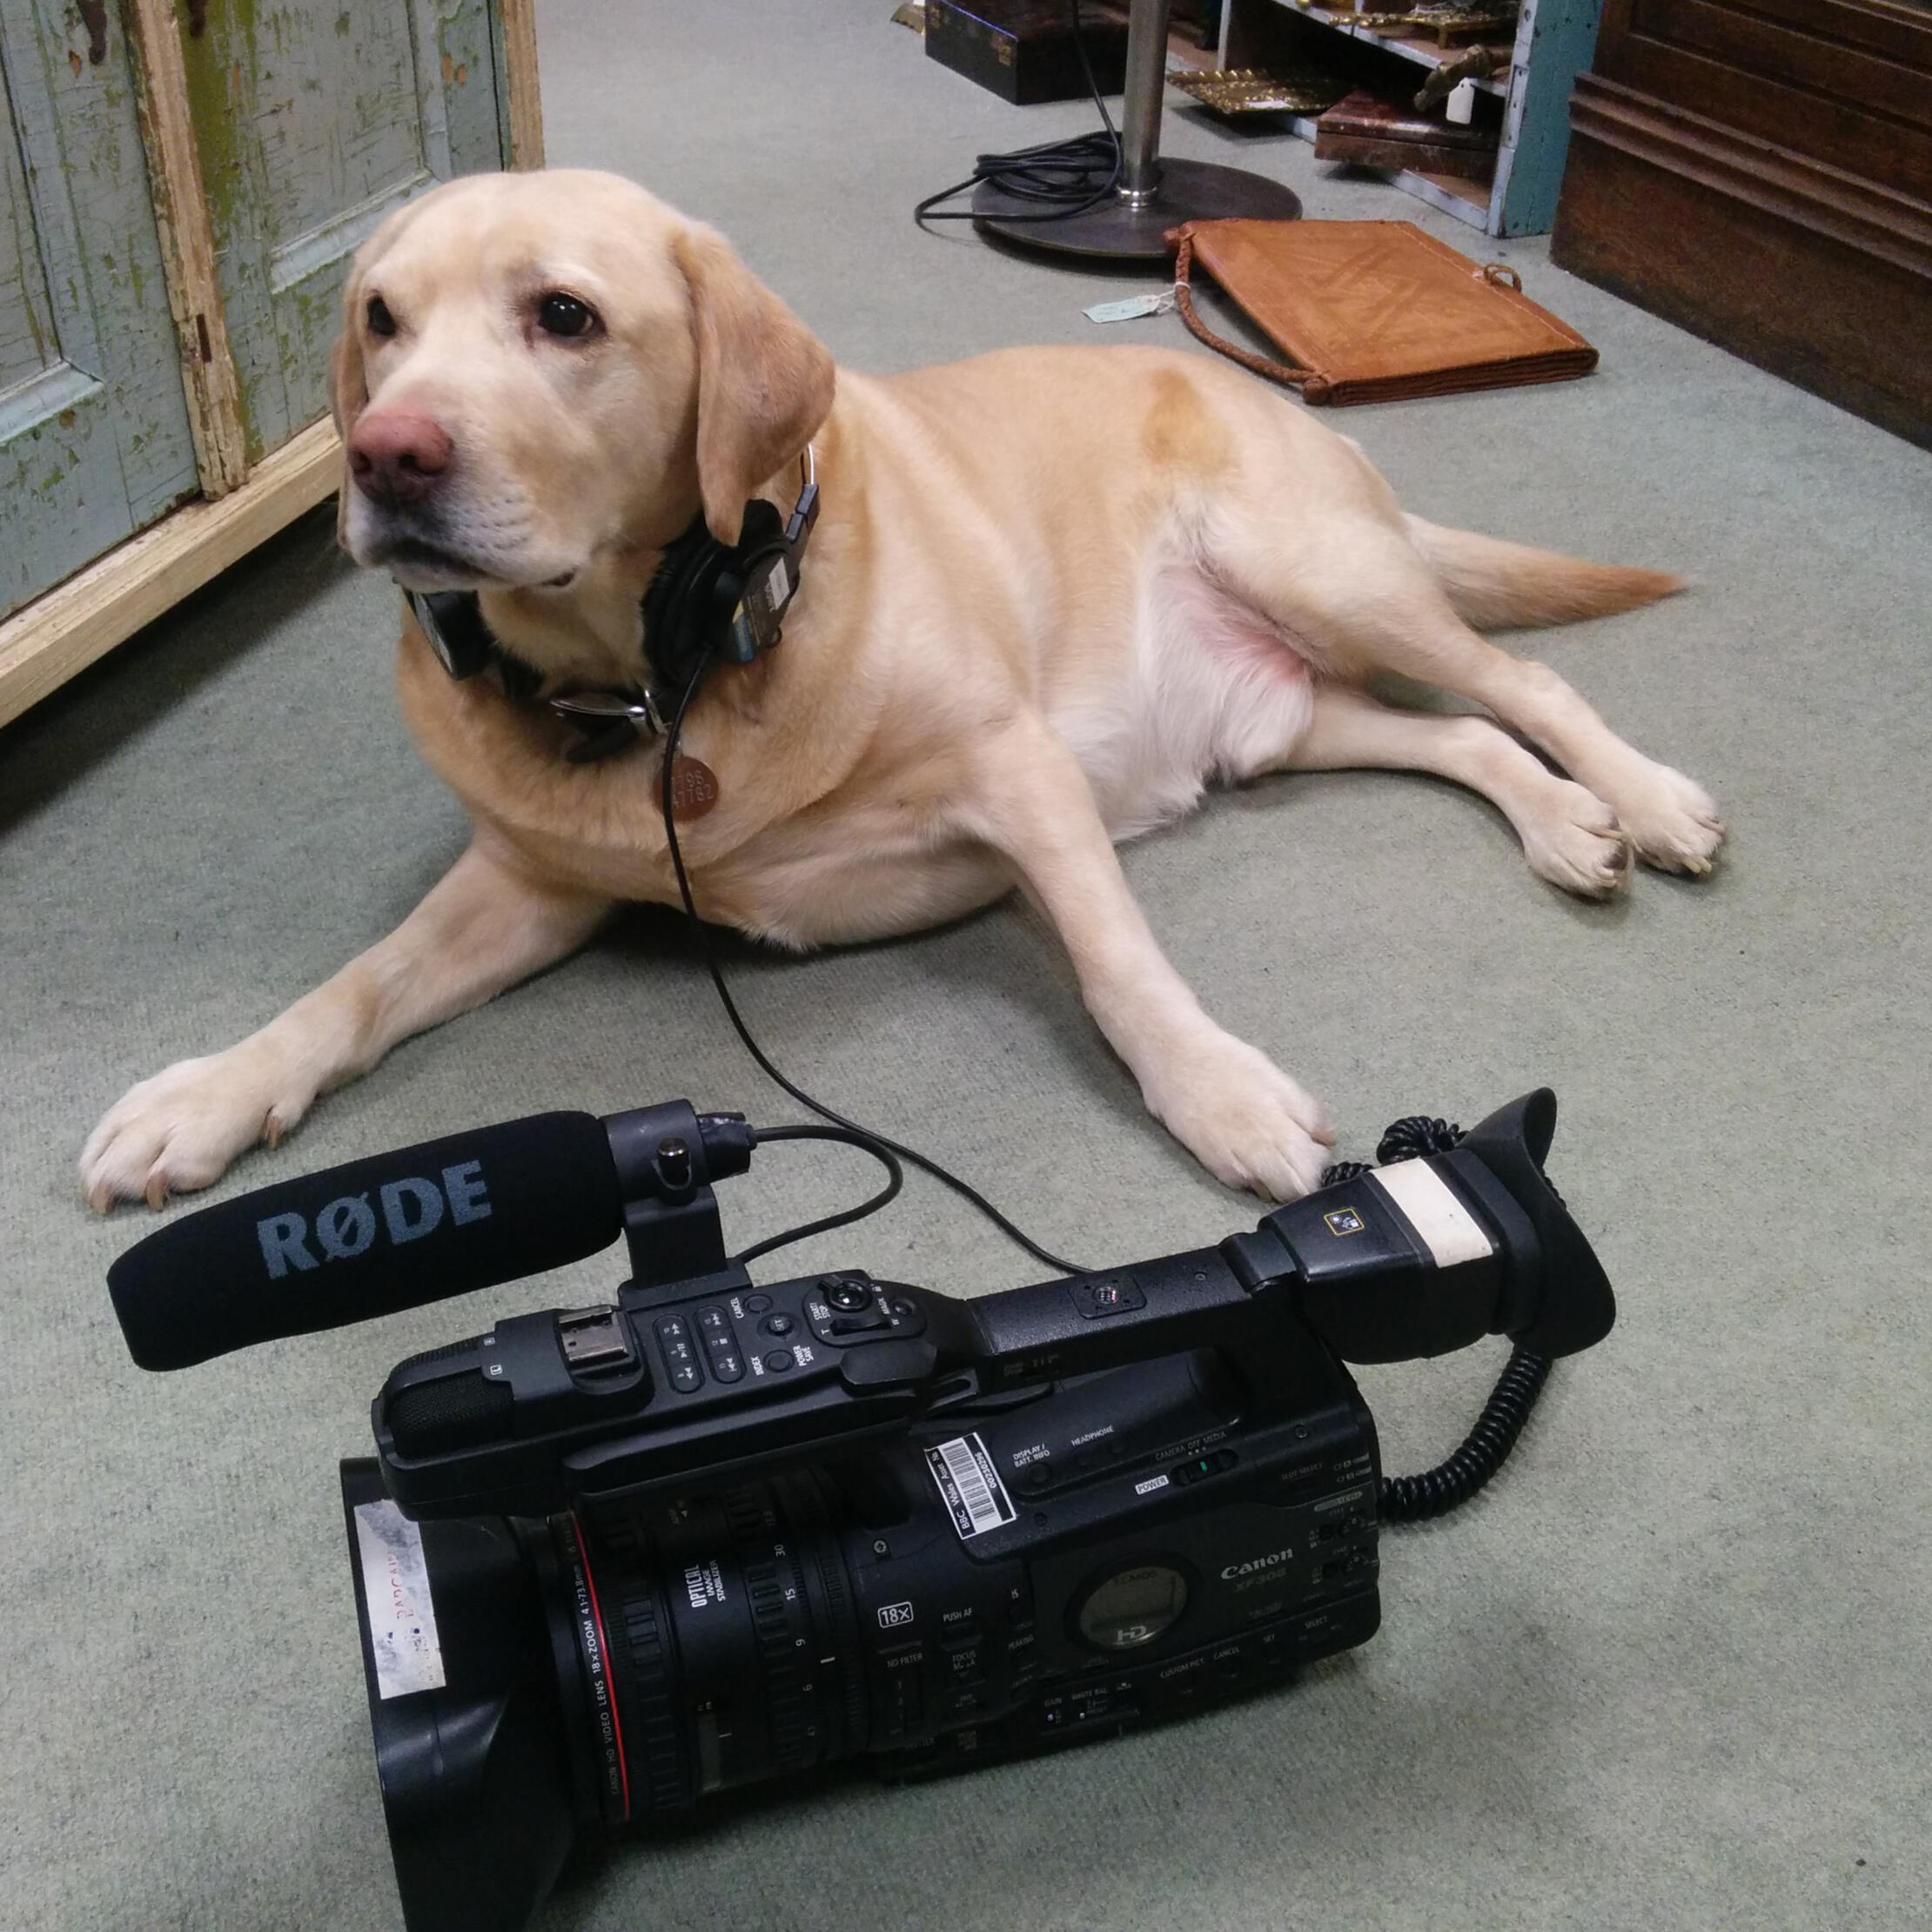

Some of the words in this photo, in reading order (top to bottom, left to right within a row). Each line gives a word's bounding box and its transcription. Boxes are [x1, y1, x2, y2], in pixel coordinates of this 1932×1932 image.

[257, 1159, 493, 1280] RØDE
[730, 1297, 745, 1320] CANCEL
[819, 1305, 832, 1319] STOP
[792, 1345, 806, 1367] POWER
[801, 1345, 815, 1364] SAVE
[749, 1355, 764, 1377] INDEX
[1070, 1426, 1115, 1446] HEADPHONE
[1155, 1445, 1185, 1462] CAMERA
[1202, 1430, 1228, 1446] MEDIA
[1012, 1445, 1040, 1461] DISPLAY
[1033, 1449, 1051, 1463] INFO
[946, 1482, 961, 1507] Wales
[1137, 1477, 1167, 1493] POWER
[953, 1507, 971, 1530] BBC
[773, 1543, 787, 1559] 30
[1219, 1546, 1295, 1581] Canon
[684, 1563, 708, 1609] OPTICAL
[783, 1587, 796, 1602] 15
[1010, 1587, 1020, 1600] IS
[881, 1606, 910, 1626] 18x
[943, 1611, 962, 1623] PUSH
[963, 1607, 974, 1617] AF
[1304, 1614, 1330, 1630] SELECT
[583, 1619, 599, 1654] ZOOM
[951, 1650, 977, 1664] FOCUS
[1212, 1646, 1240, 1661] CANCEL
[1159, 1663, 1187, 1679] CUSTOM
[594, 1679, 607, 1707] LENS
[599, 1711, 614, 1744] VIDEO
